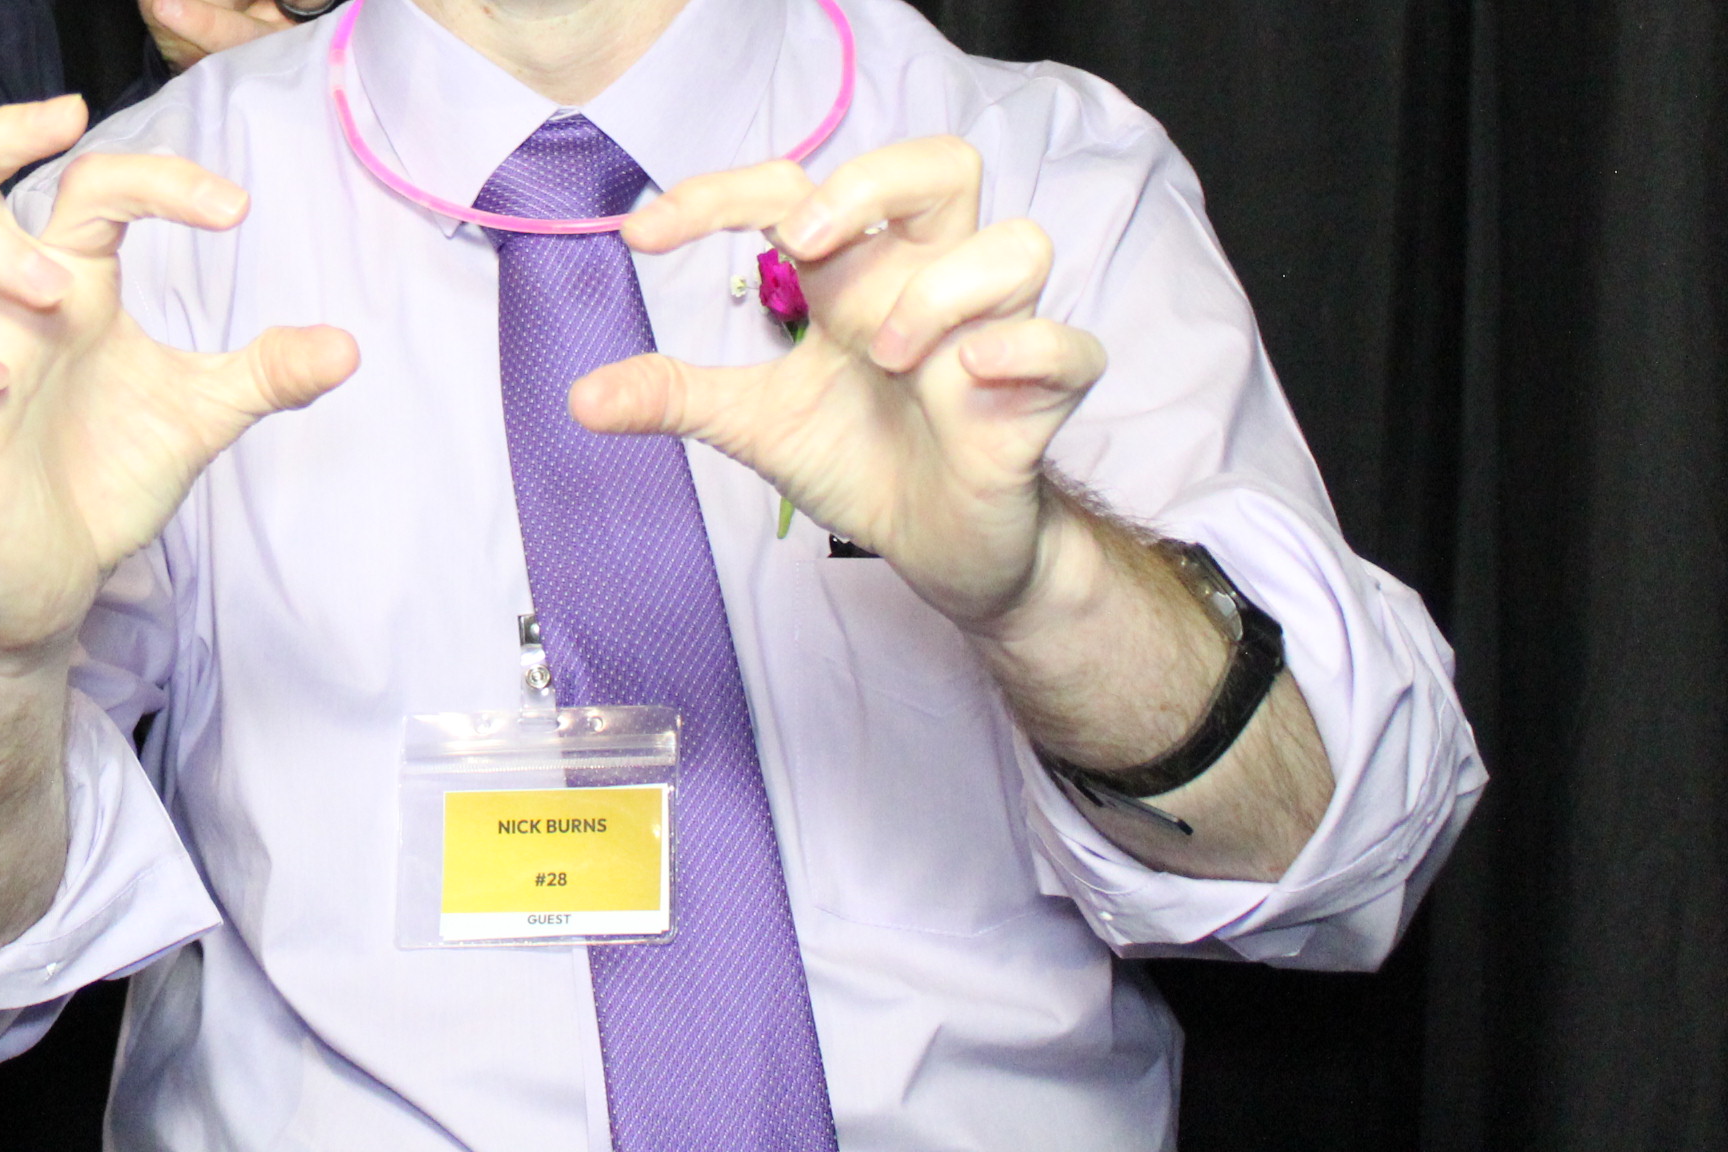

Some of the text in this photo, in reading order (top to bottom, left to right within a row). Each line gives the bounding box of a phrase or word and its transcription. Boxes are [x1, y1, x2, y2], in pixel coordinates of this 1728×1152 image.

[498, 818, 607, 834] NICK BURNS
[535, 872, 568, 887] #28
[527, 914, 572, 925] GUEST
